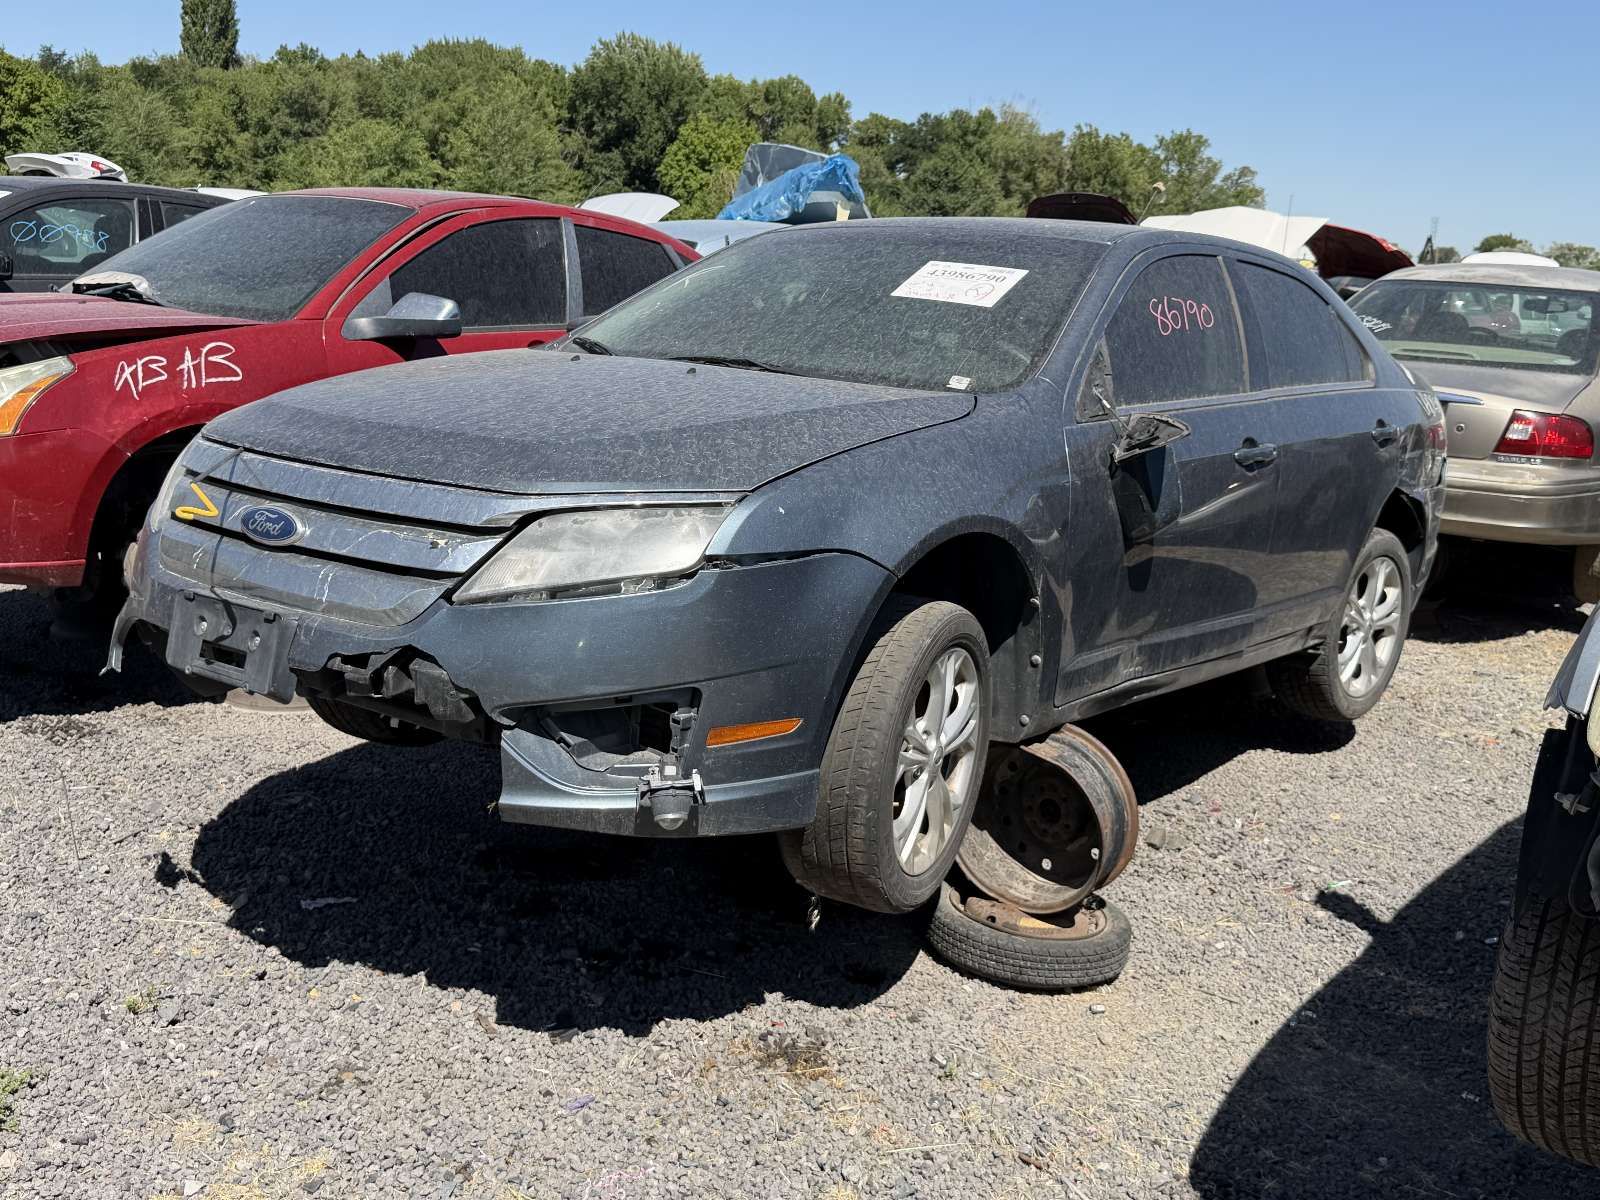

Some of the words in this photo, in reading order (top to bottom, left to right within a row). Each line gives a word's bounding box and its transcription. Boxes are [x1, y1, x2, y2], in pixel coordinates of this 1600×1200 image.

[1149, 295, 1214, 336] 86790
[176, 341, 243, 389] AB
[248, 510, 286, 536] Ford
